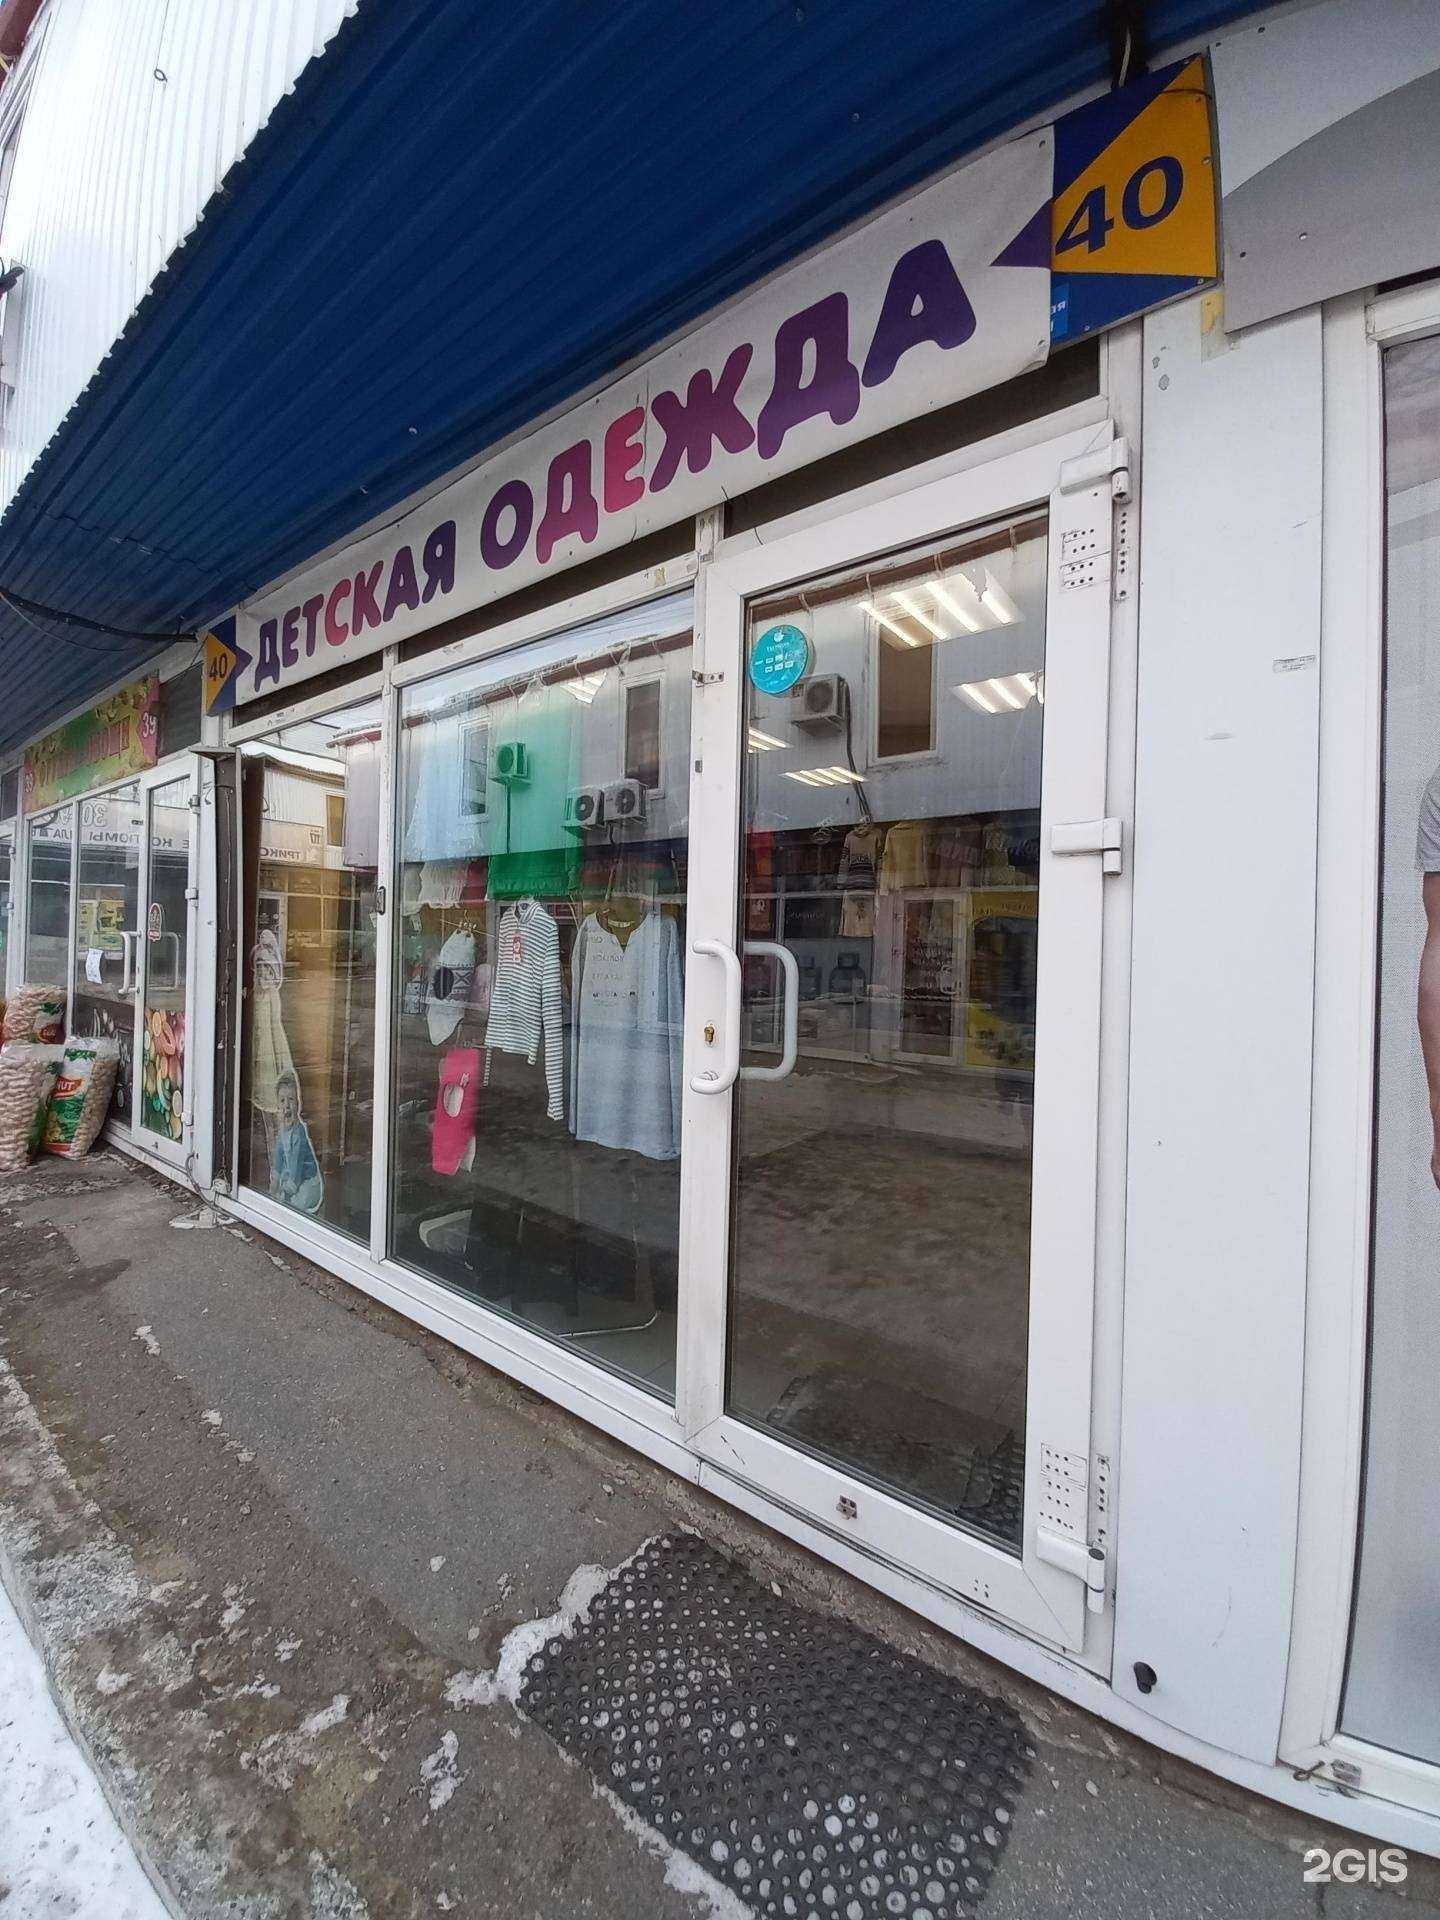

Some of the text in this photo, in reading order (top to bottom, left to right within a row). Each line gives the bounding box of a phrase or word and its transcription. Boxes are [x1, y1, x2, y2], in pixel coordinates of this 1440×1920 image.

[1054, 155, 1184, 255] 40
[254, 239, 976, 693] ДЕТСКАЯ ОДЕЖДА
[209, 652, 228, 681] 40
